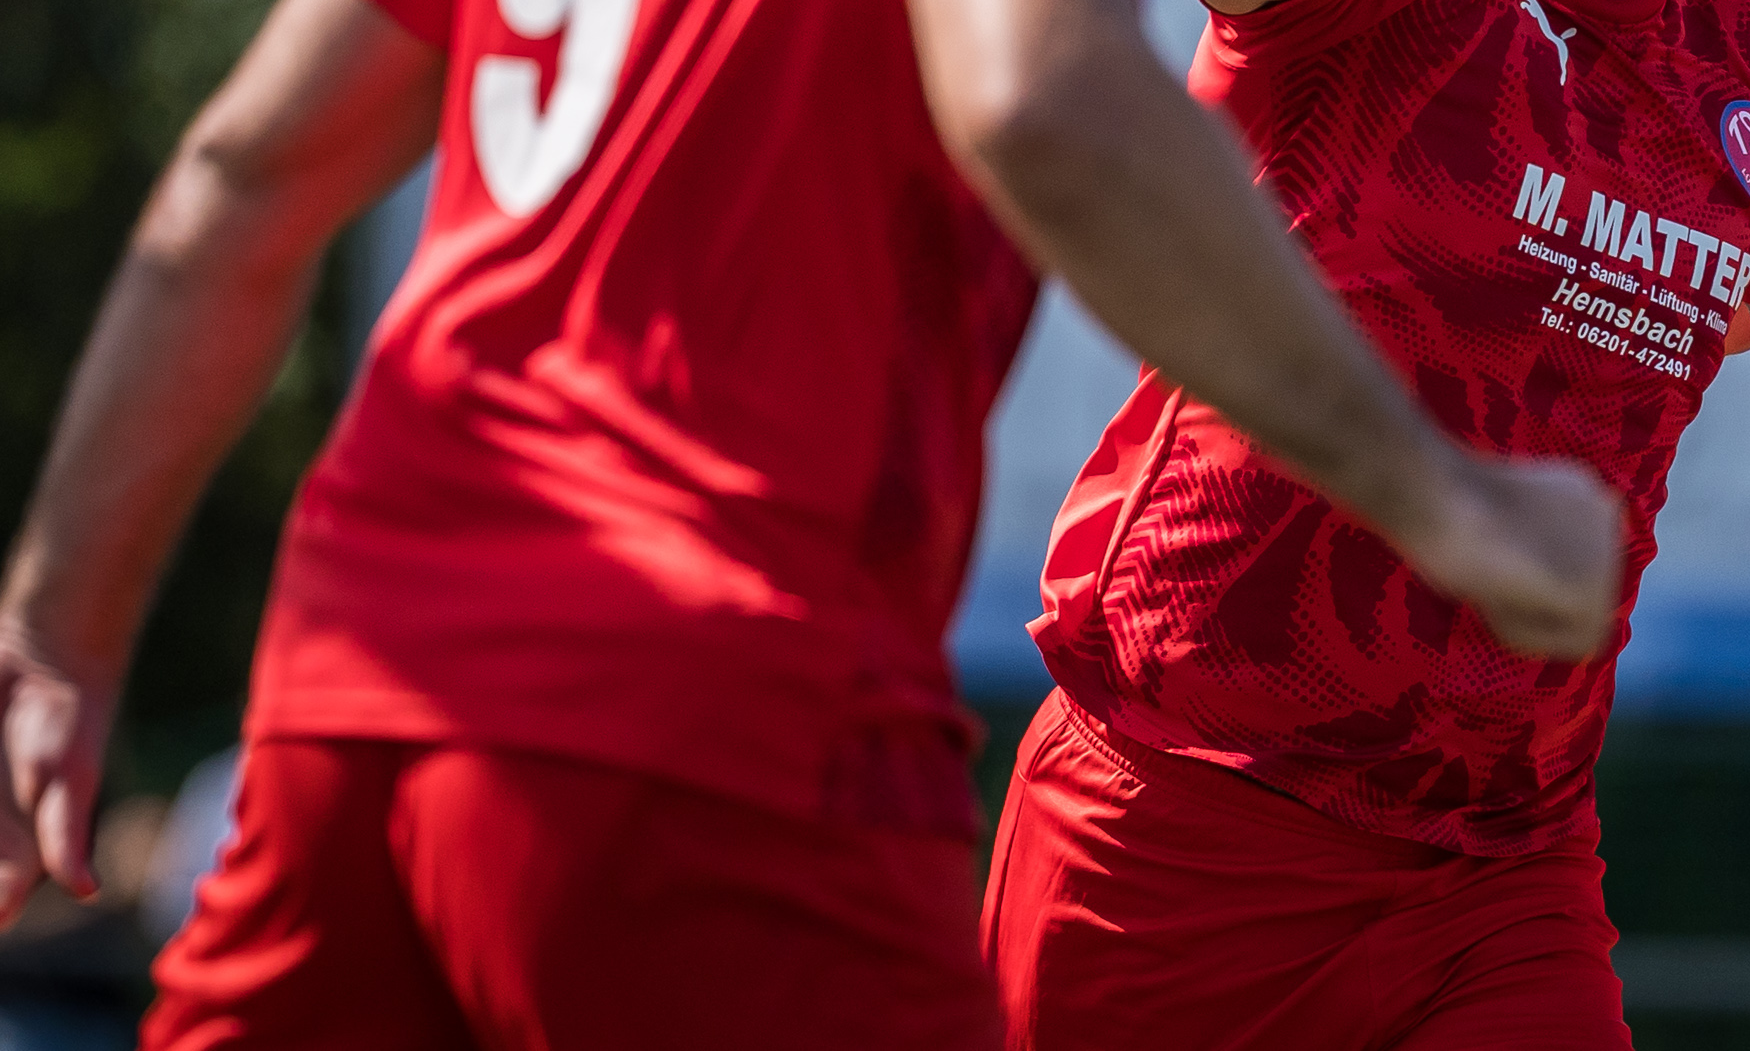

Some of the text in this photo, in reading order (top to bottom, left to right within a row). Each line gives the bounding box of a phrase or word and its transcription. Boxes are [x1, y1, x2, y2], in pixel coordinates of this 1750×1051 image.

[1512, 162, 1569, 236] M.
[1518, 234, 1578, 275] Heizung
[1589, 262, 1641, 295] Sanitär
[1650, 285, 1700, 324] Lüftung
[1551, 278, 1694, 355] Hemsbach
[1540, 307, 1691, 381] Tel.: 06201-472491
